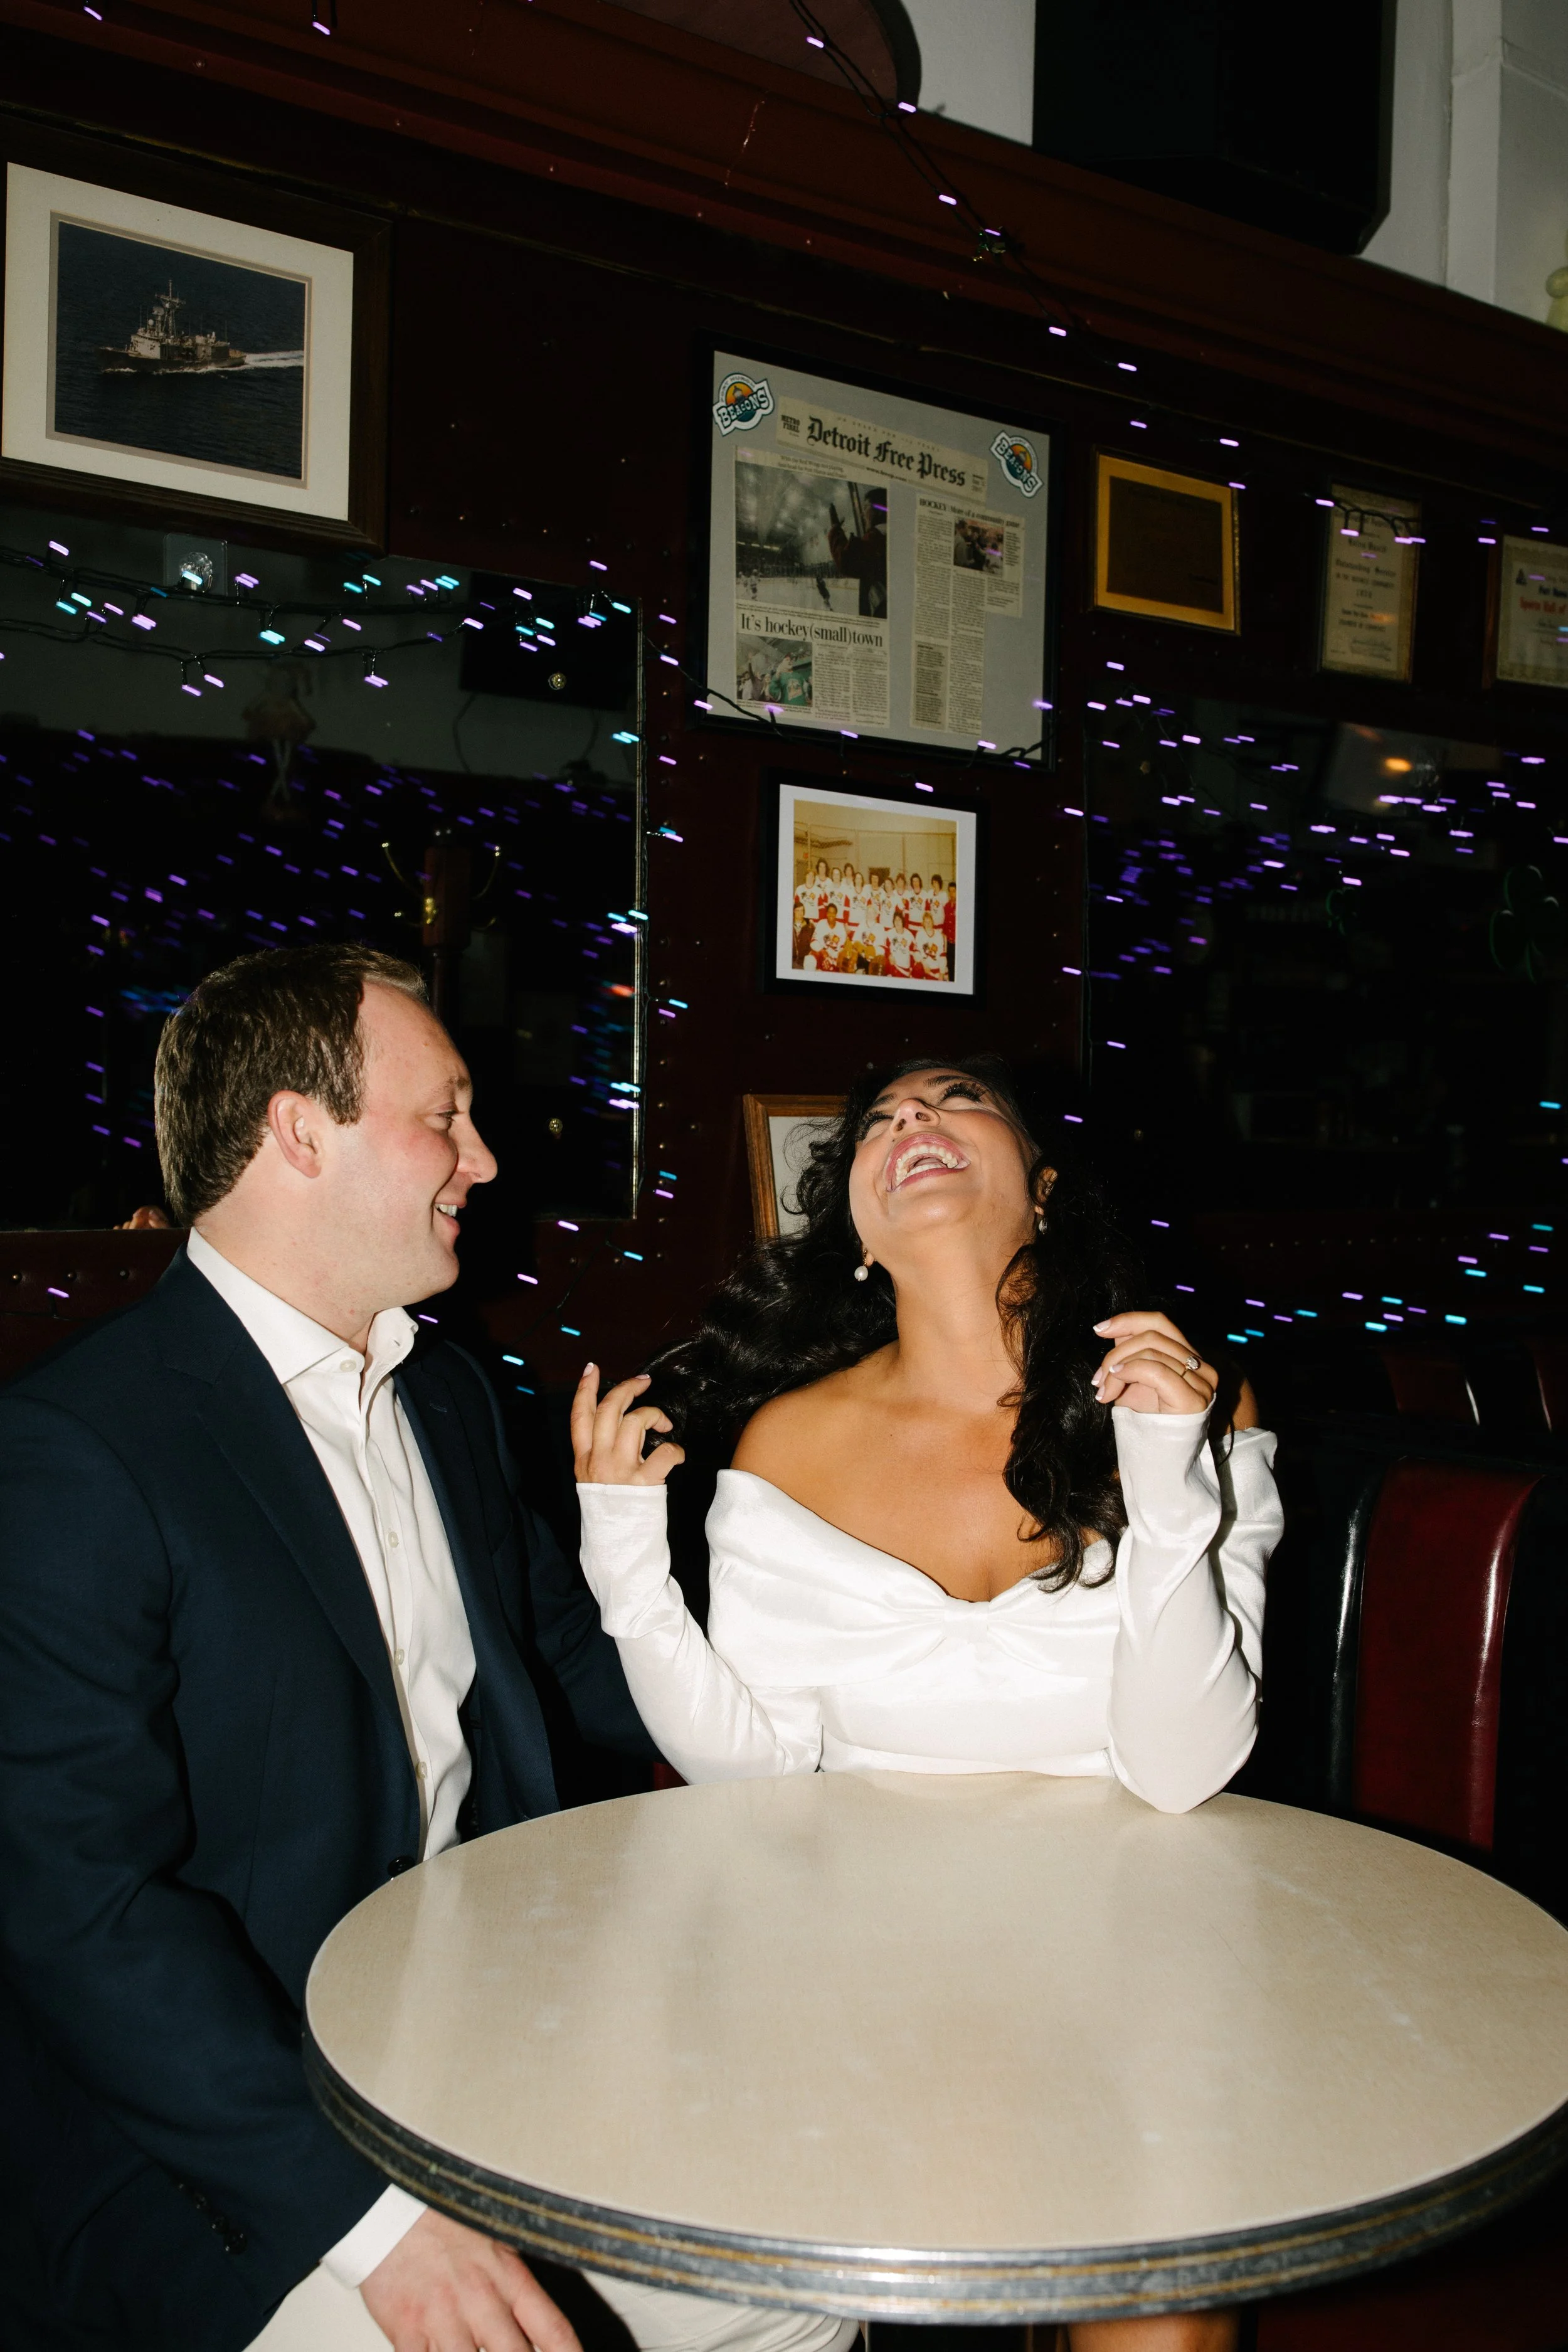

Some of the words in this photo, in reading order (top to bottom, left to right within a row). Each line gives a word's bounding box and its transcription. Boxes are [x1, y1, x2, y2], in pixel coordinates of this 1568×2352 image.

[717, 388, 770, 429] BEACONS
[807, 415, 871, 457] Detroit
[873, 441, 914, 470] Free
[916, 452, 965, 487] Press
[995, 438, 1038, 493] BEACONS
[919, 498, 946, 511] HOCKEY
[741, 613, 761, 632] It's
